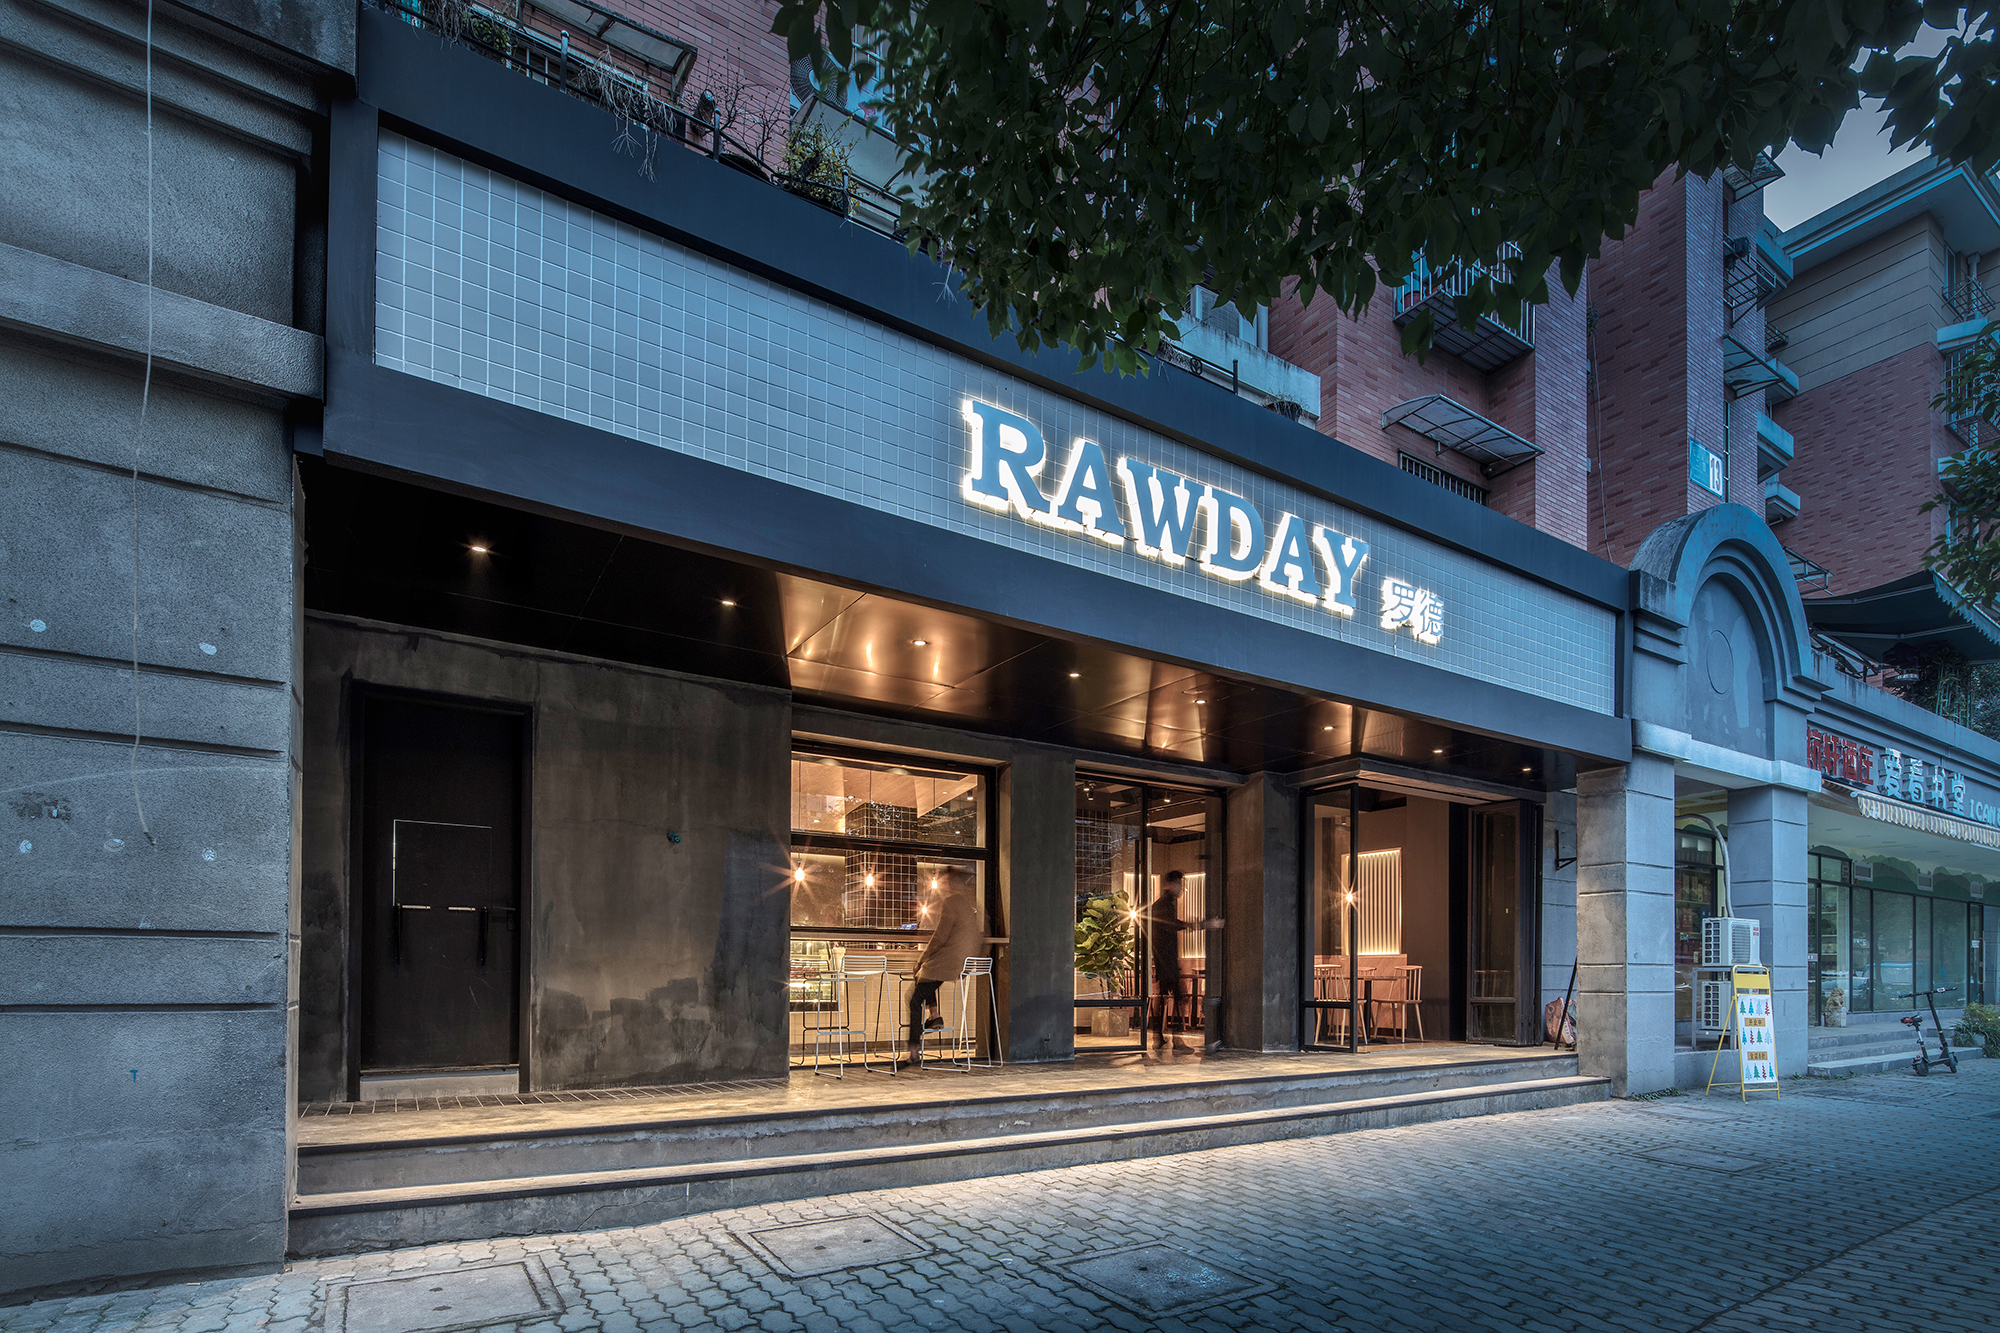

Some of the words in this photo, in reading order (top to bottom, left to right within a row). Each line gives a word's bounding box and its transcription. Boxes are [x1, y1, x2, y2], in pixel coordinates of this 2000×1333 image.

[970, 399, 1370, 610] RAWDAY
[1710, 457, 1721, 491] 13
[1390, 581, 1445, 636] 罗德
[1882, 747, 1966, 817] 爱看书堂
